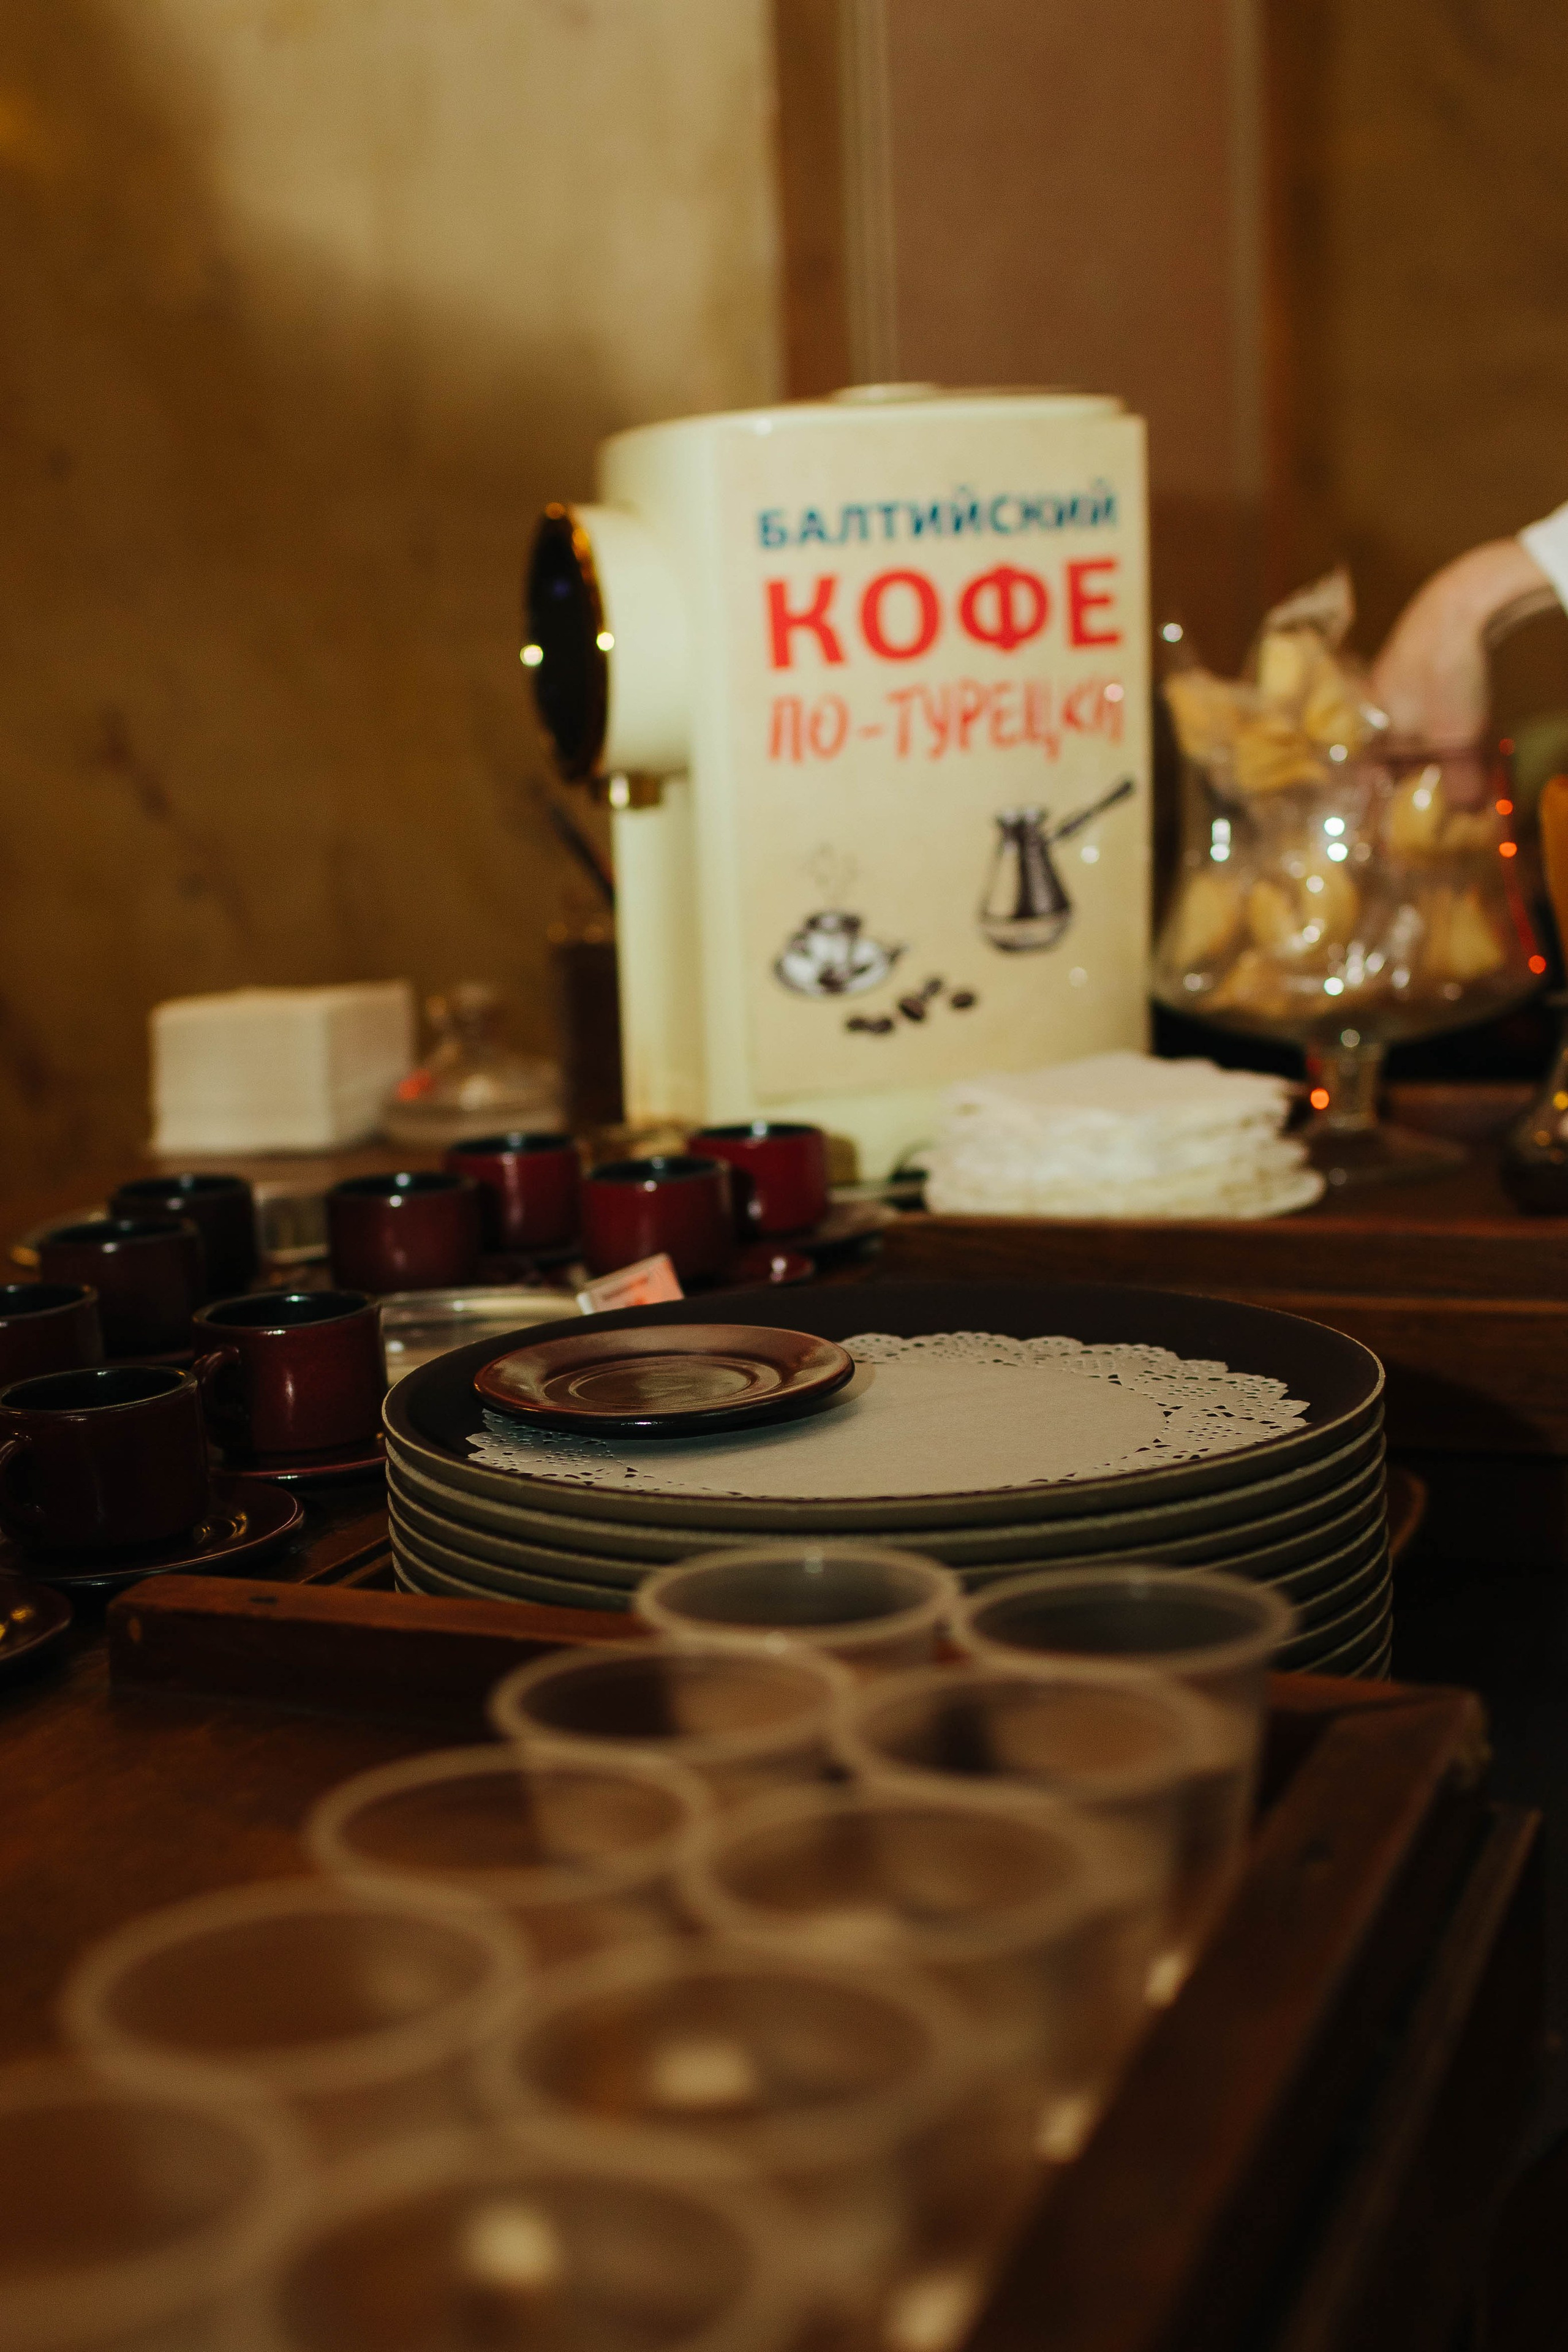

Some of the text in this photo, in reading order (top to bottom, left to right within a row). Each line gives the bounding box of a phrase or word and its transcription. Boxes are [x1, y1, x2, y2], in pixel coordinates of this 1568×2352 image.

[757, 477, 1118, 549] БАЛТИЙСКИЙ
[766, 556, 1122, 671] КОФЕ
[766, 677, 1125, 764] ПО-ТУРЕЦКИ
